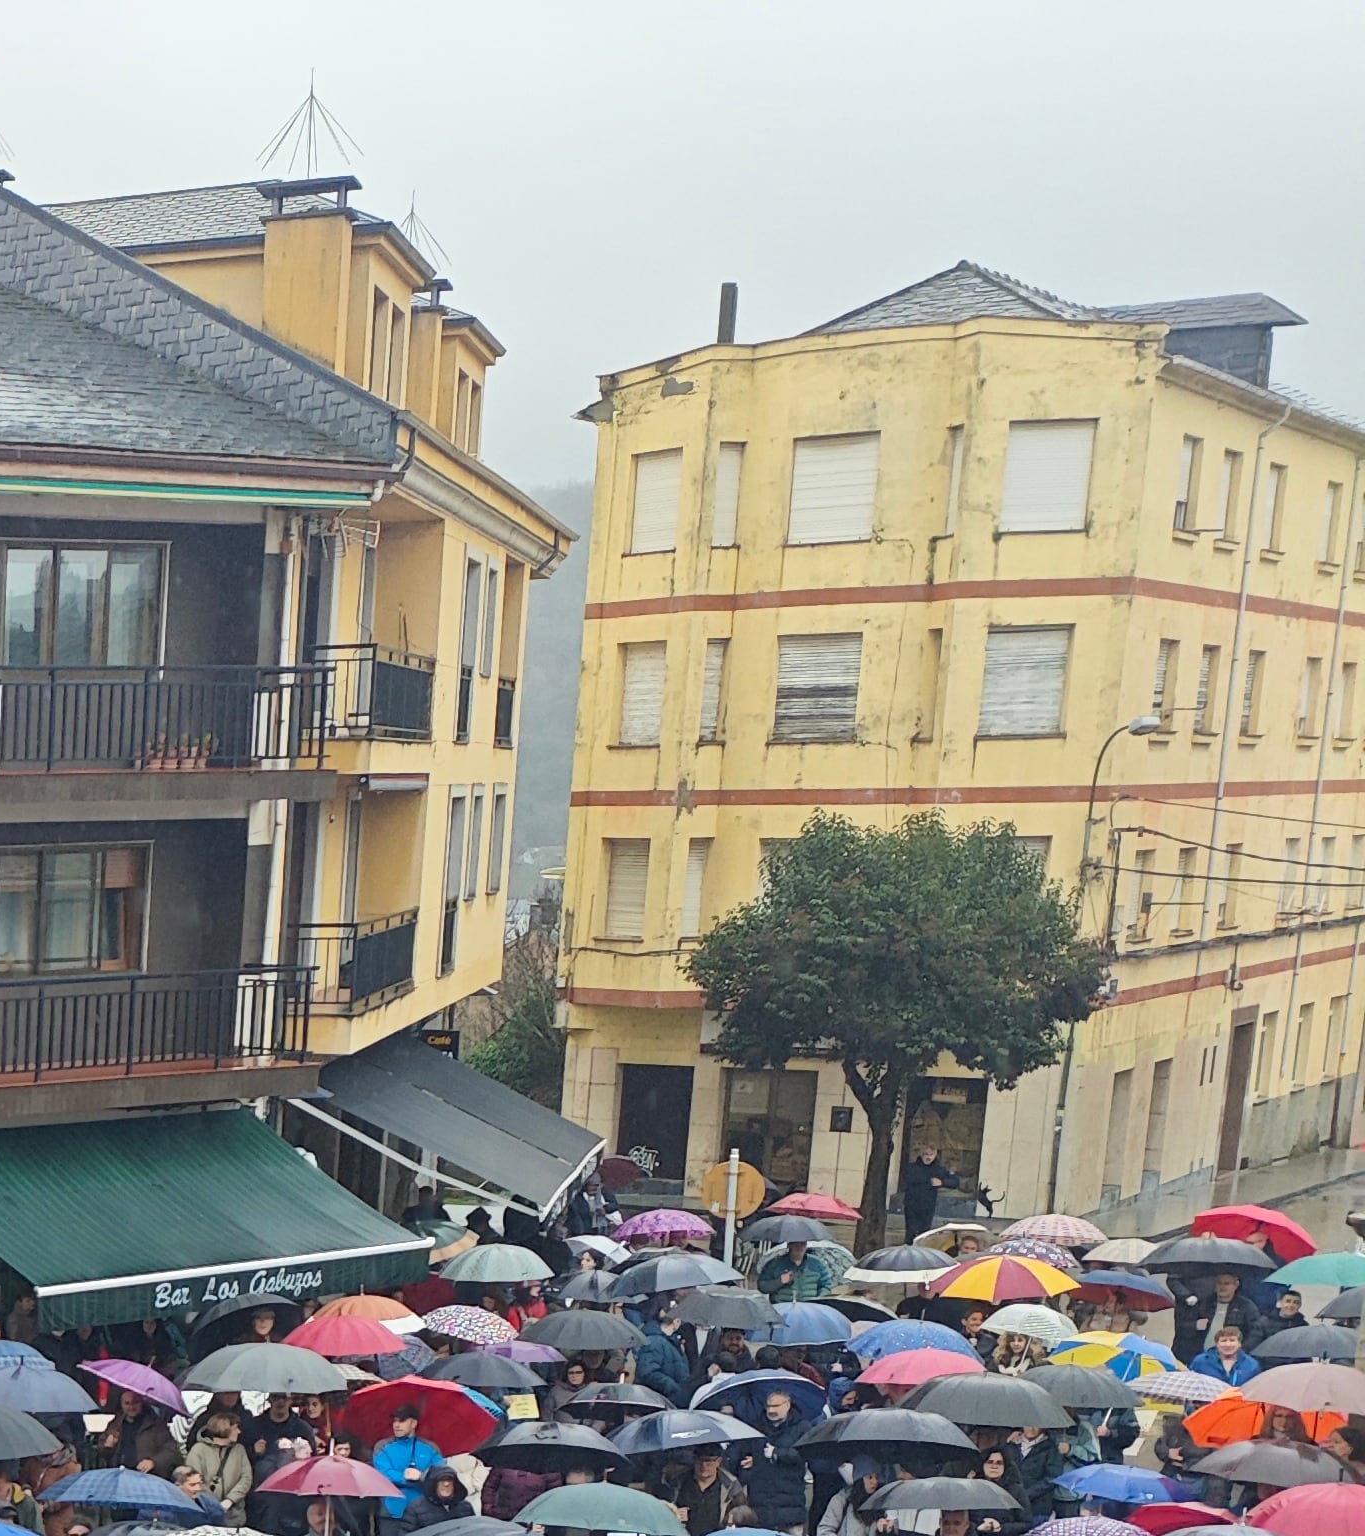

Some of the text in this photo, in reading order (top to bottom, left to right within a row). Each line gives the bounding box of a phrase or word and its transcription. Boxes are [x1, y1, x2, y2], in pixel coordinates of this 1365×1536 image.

[154, 1267, 323, 1309] Bar Los Gabuzos
